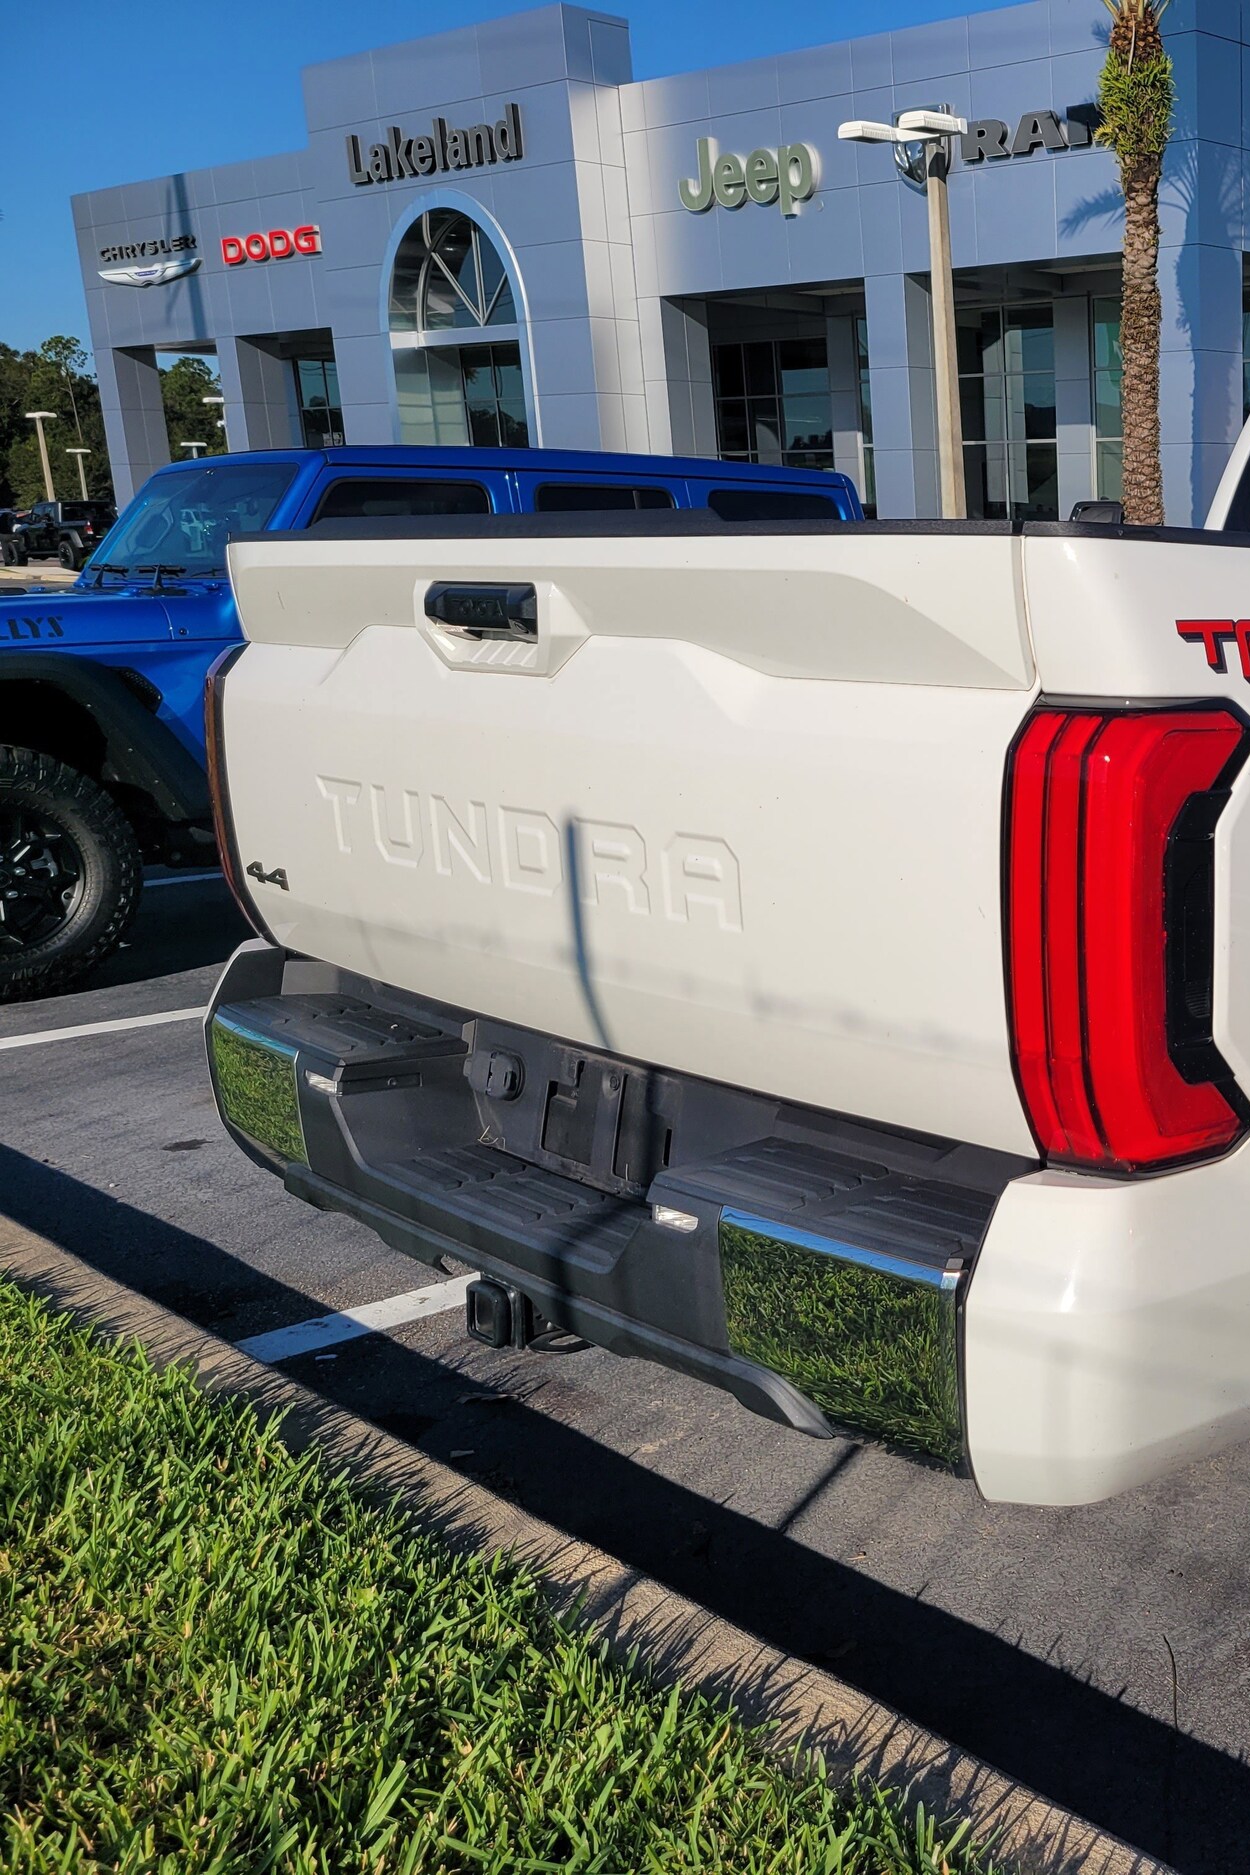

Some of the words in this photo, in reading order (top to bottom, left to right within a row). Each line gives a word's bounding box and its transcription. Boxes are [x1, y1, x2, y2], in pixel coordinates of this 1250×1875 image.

[346, 103, 523, 185] Lakeland
[678, 137, 820, 218] Jeep
[100, 234, 198, 262] CHRYSLER
[221, 225, 321, 266] DODG
[316, 774, 744, 932] TUNDRA
